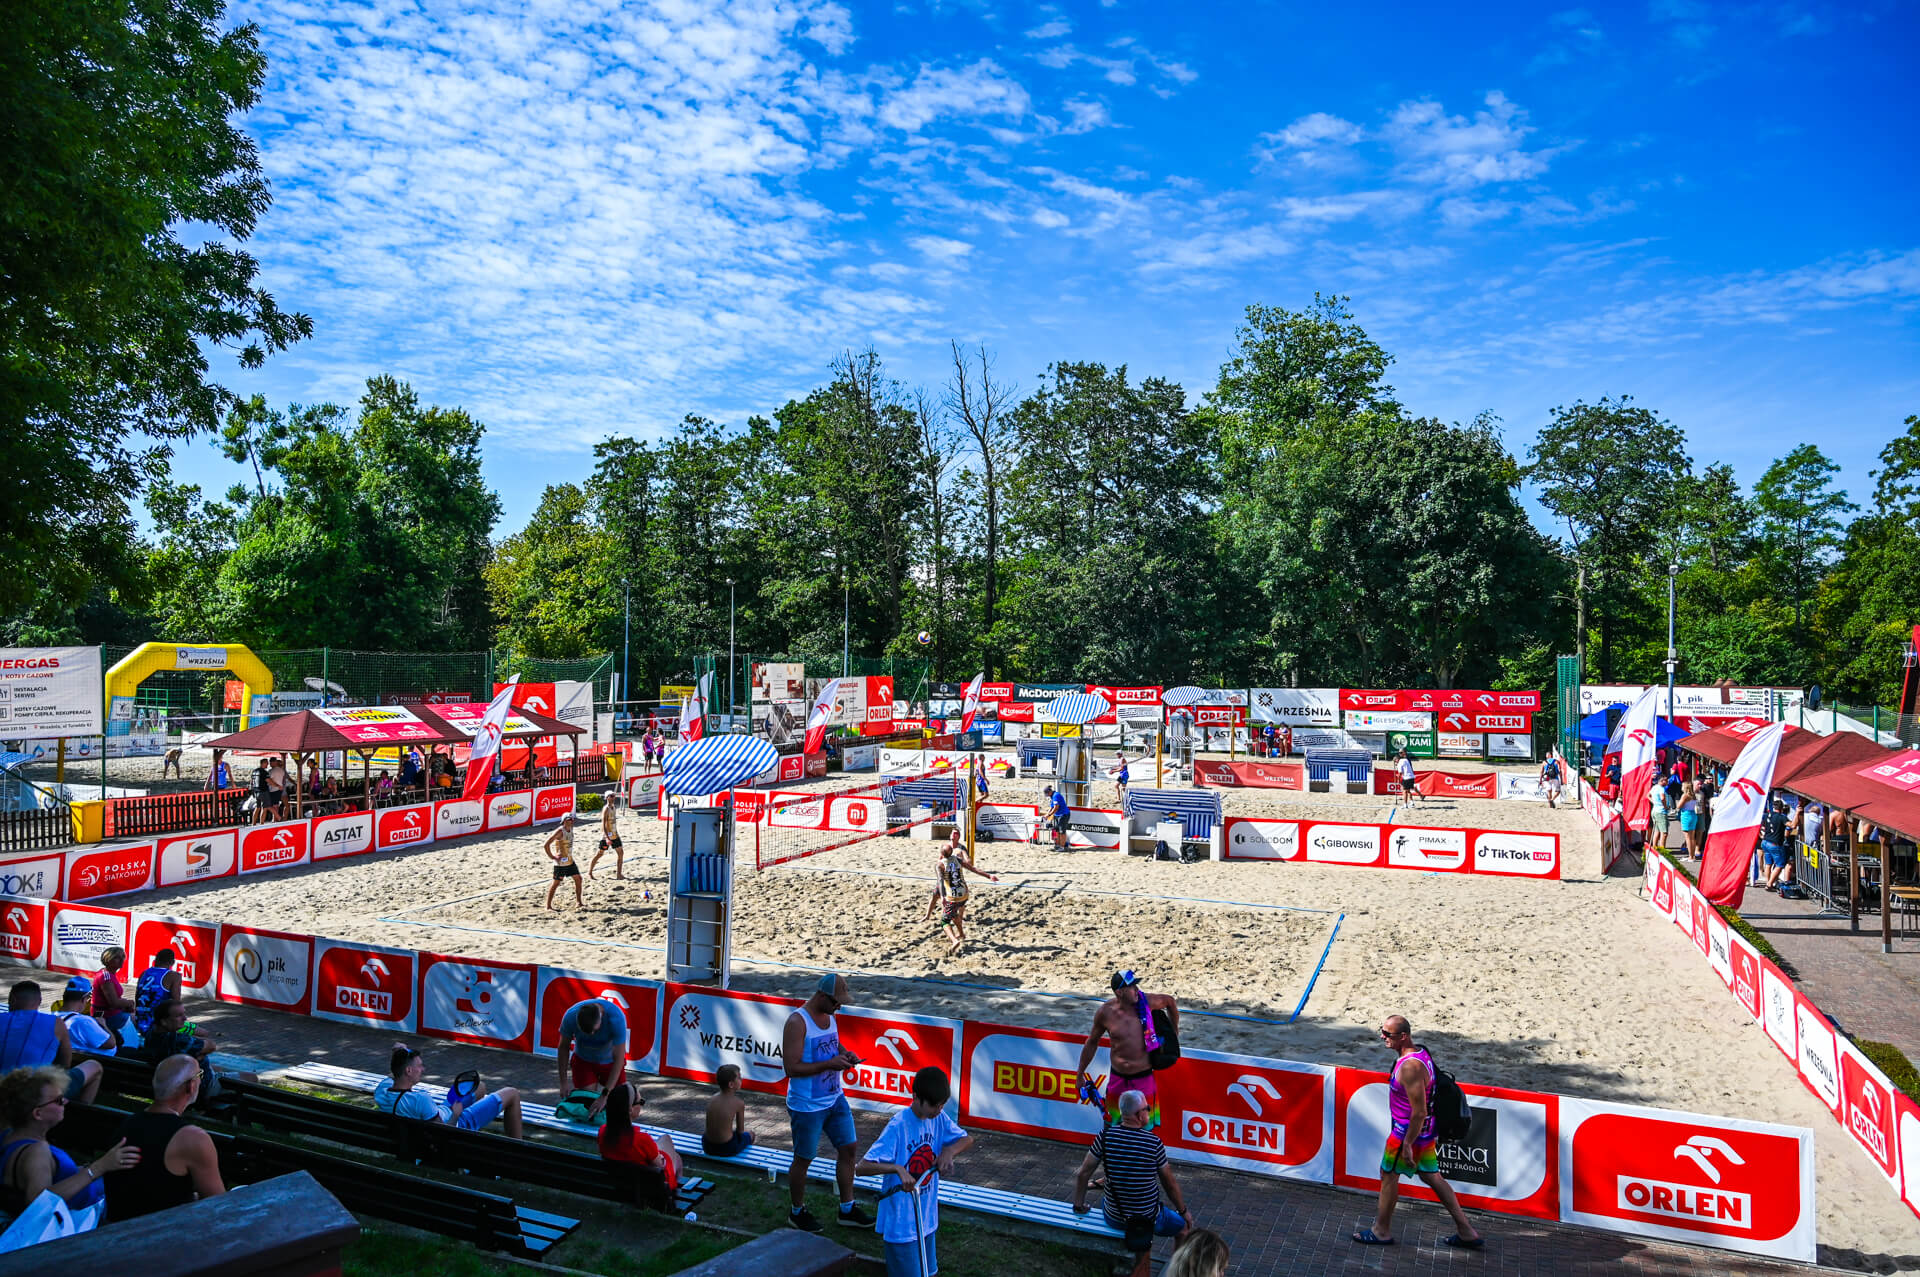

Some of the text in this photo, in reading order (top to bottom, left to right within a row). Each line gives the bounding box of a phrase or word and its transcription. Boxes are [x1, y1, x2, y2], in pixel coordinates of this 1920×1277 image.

[188, 657, 225, 665] WRZEŚNIA
[1119, 691, 1154, 699] ORLEN
[1688, 695, 1703, 703] pik
[869, 708, 890, 719] ORLEN
[1273, 706, 1332, 717] WRZEŚNIA
[1478, 716, 1521, 727] ORLEN
[1409, 738, 1431, 747] KAMI
[1440, 736, 1480, 747] zelka
[1206, 775, 1232, 783] ORLEN
[450, 815, 481, 826] WRZEŚNIA
[324, 826, 363, 844] ASTAT
[391, 829, 420, 841] ORLEN
[1419, 836, 1446, 844] PIMAX
[1326, 840, 1373, 849] GIBOWSKI
[258, 848, 293, 863] ORLEN
[1491, 848, 1531, 860] TikTok
[104, 860, 147, 874] POLSKA
[104, 868, 146, 882] SIATKÓWKA
[267, 956, 286, 973] pik
[285, 976, 298, 986] mpt
[339, 989, 388, 1011] ORLEN
[700, 1031, 783, 1058] WRZEŚNIA
[1805, 1045, 1835, 1087] WRZEŚNIA
[842, 1066, 915, 1095] ORLEN
[1187, 1115, 1279, 1150] ORLEN
[1854, 1114, 1884, 1158] ORLEN
[1624, 1181, 1743, 1223] ORLEN
